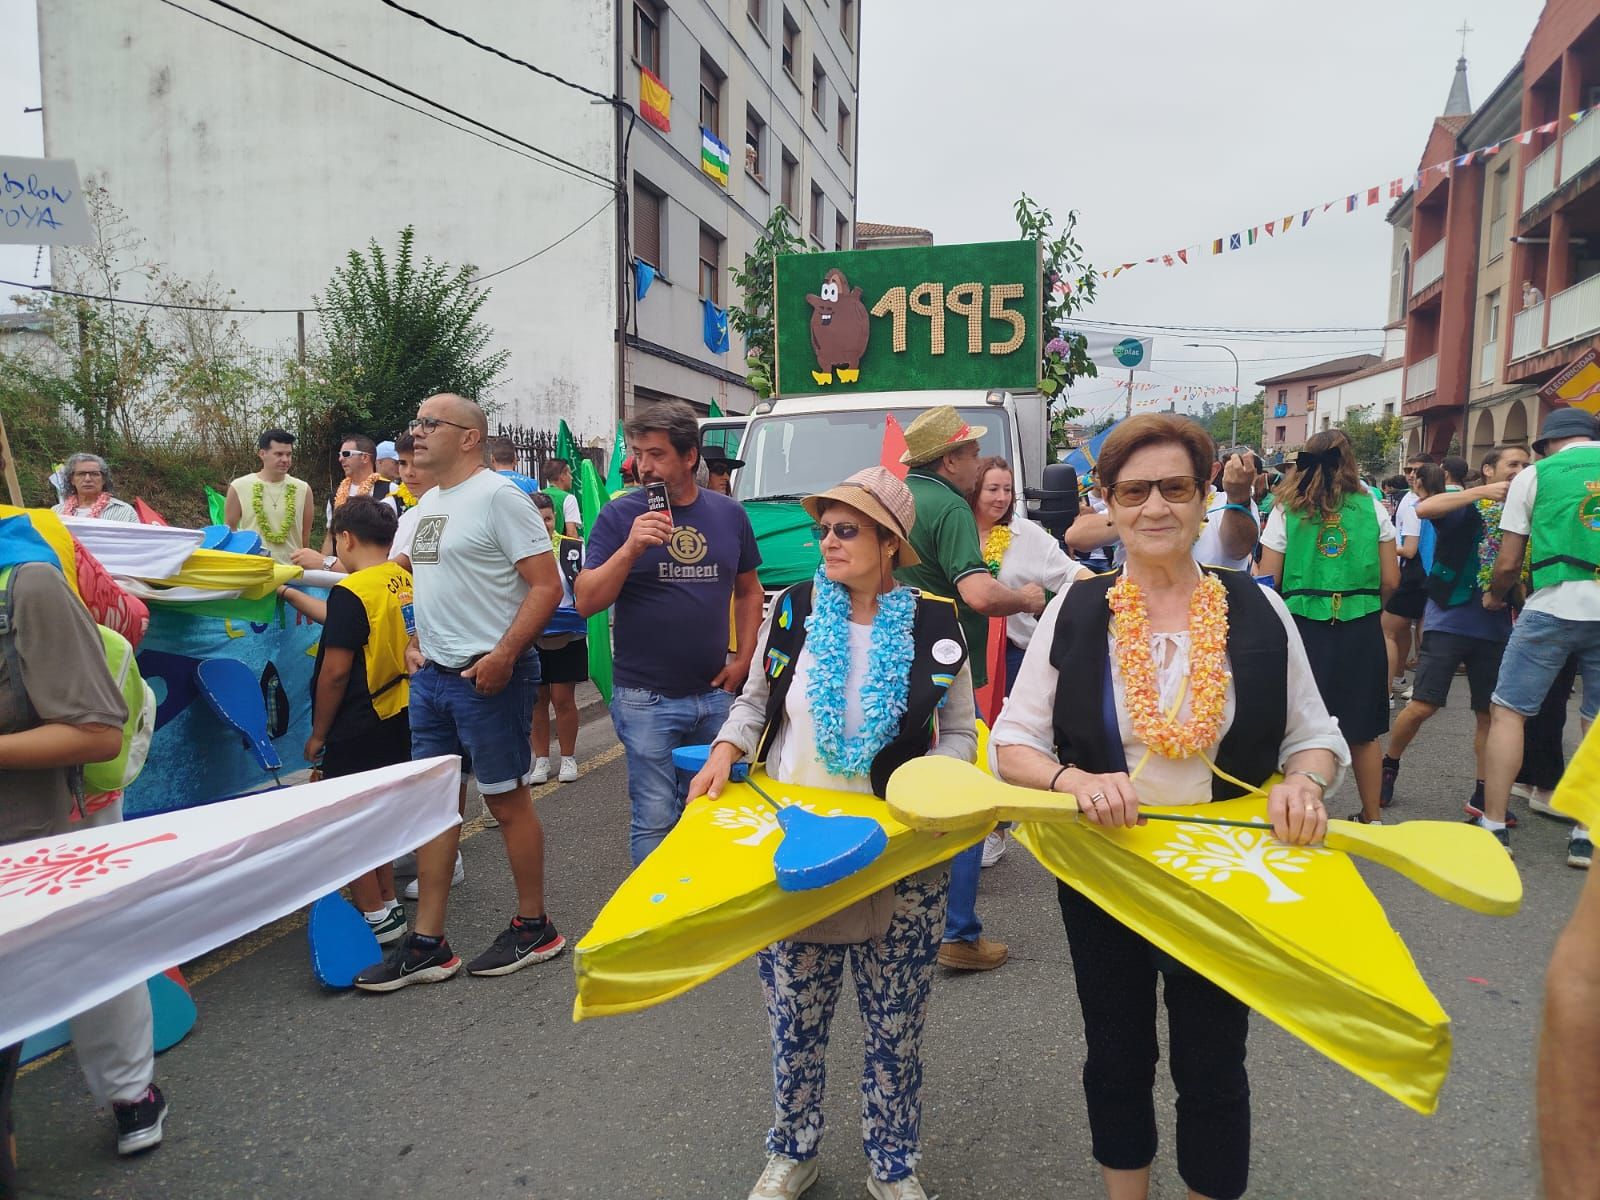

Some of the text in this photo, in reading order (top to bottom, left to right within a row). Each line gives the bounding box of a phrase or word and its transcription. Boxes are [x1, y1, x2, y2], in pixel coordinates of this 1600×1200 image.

[0, 203, 64, 230] OYA
[870, 281, 1026, 355] 1995
[1544, 352, 1597, 396] ELECTRICIDAD
[657, 561, 719, 578] Element
[387, 575, 413, 594] COYA
